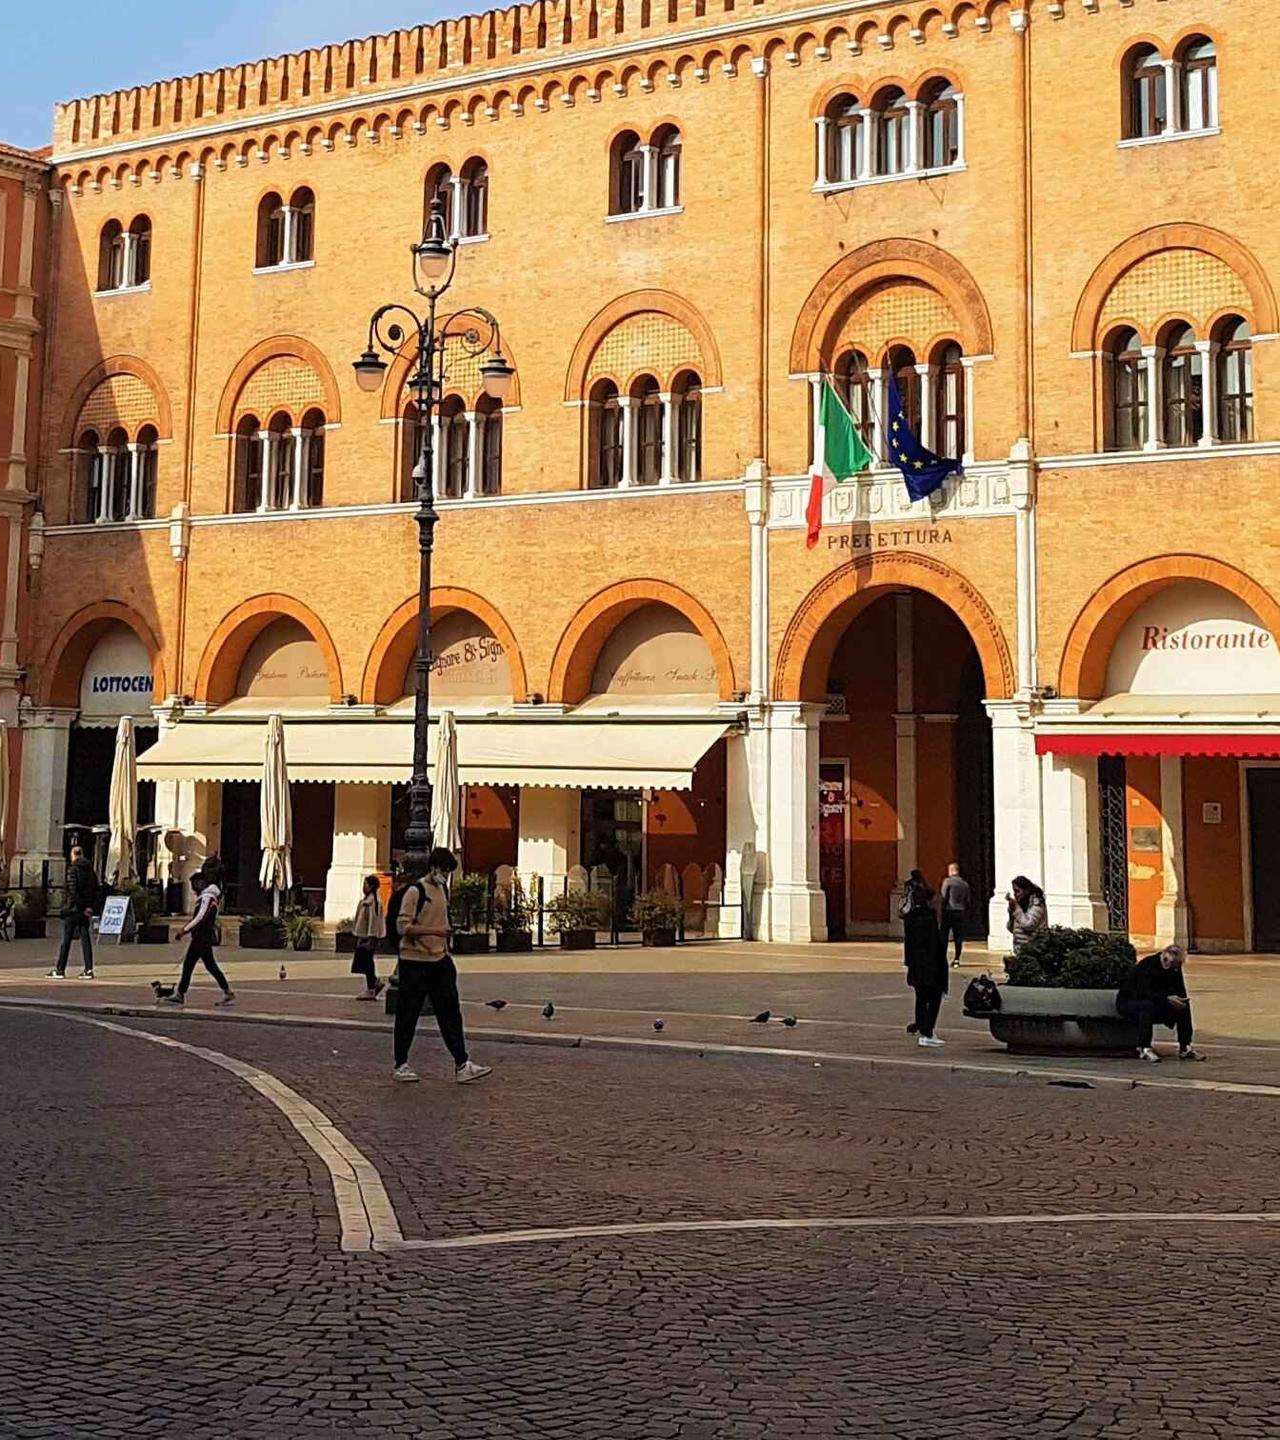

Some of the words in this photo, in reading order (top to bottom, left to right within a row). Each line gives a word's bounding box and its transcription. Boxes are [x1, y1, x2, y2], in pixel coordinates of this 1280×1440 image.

[827, 529, 953, 550] PREFETTURA
[479, 635, 506, 663] Sign
[1141, 625, 1270, 651] Ristorante
[92, 675, 154, 693] LOTTOCEN
